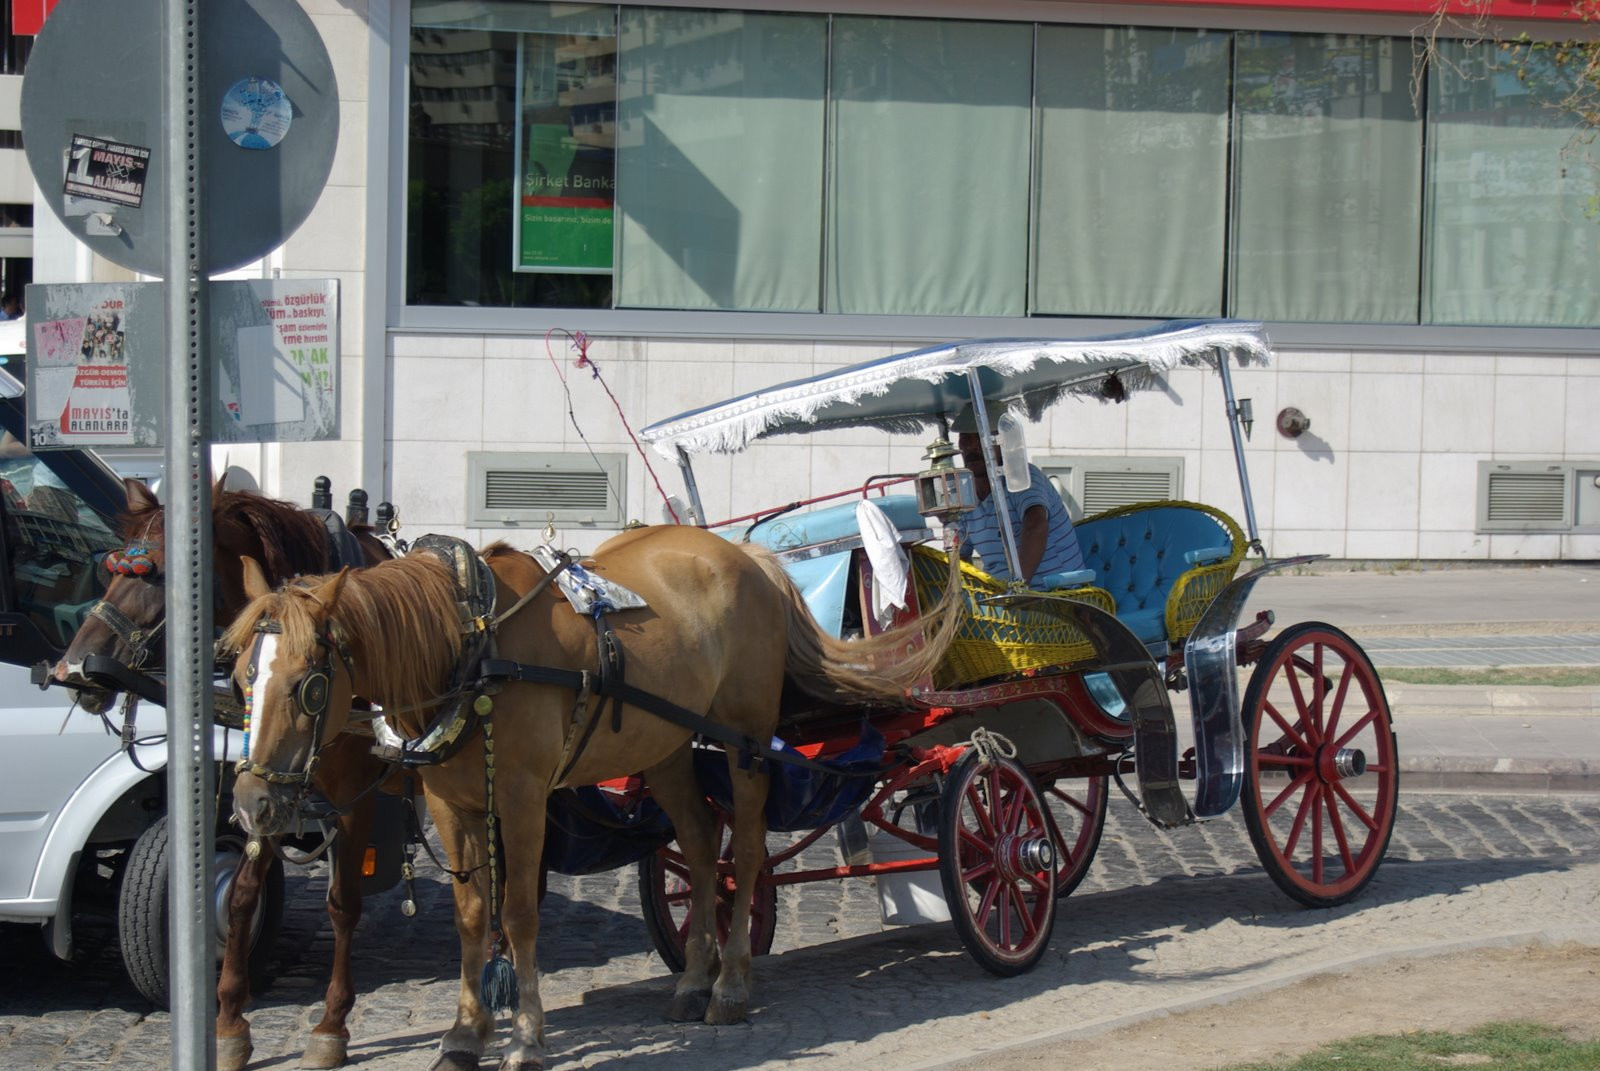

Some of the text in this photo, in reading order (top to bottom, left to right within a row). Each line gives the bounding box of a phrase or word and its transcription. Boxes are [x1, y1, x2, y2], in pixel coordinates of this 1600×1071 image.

[285, 294, 326, 306] özgürlük
[71, 421, 128, 431] ALANLARA
[32, 434, 46, 445] 10
